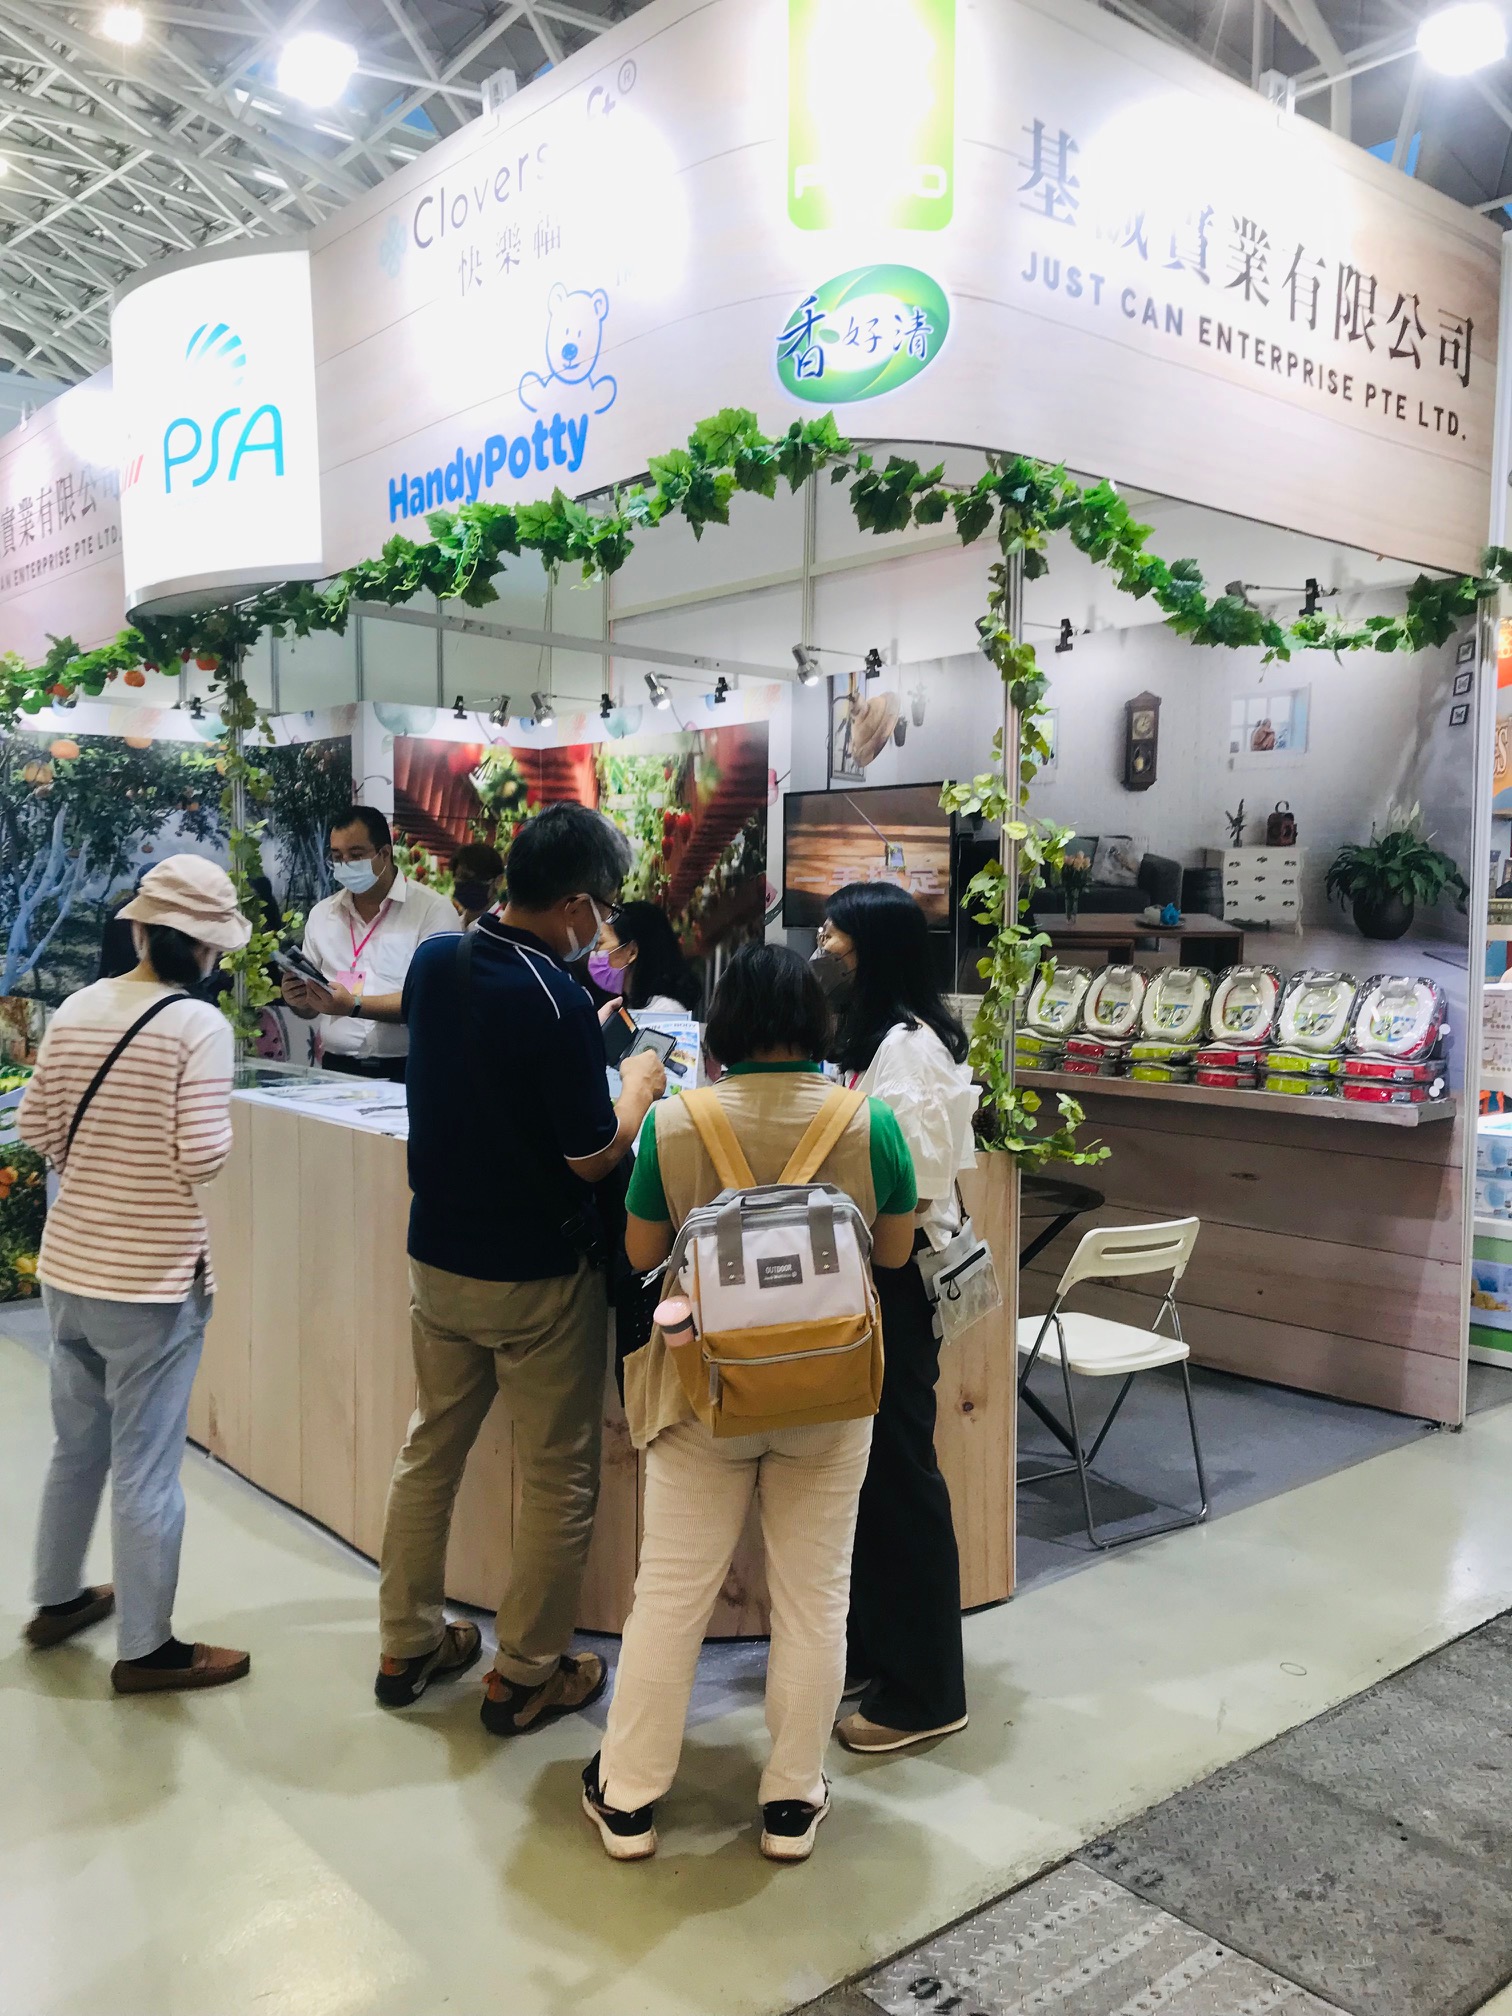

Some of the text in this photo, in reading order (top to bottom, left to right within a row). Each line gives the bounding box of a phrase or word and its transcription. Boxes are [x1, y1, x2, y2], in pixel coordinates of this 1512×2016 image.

[1020, 250, 1467, 442] JUST CAN ENTERPRISE PTE LTD.
[163, 403, 284, 494] PSA
[388, 412, 588, 524] HandyPotty
[14, 545, 71, 587] ENTERPRISE
[74, 534, 94, 561] PTE
